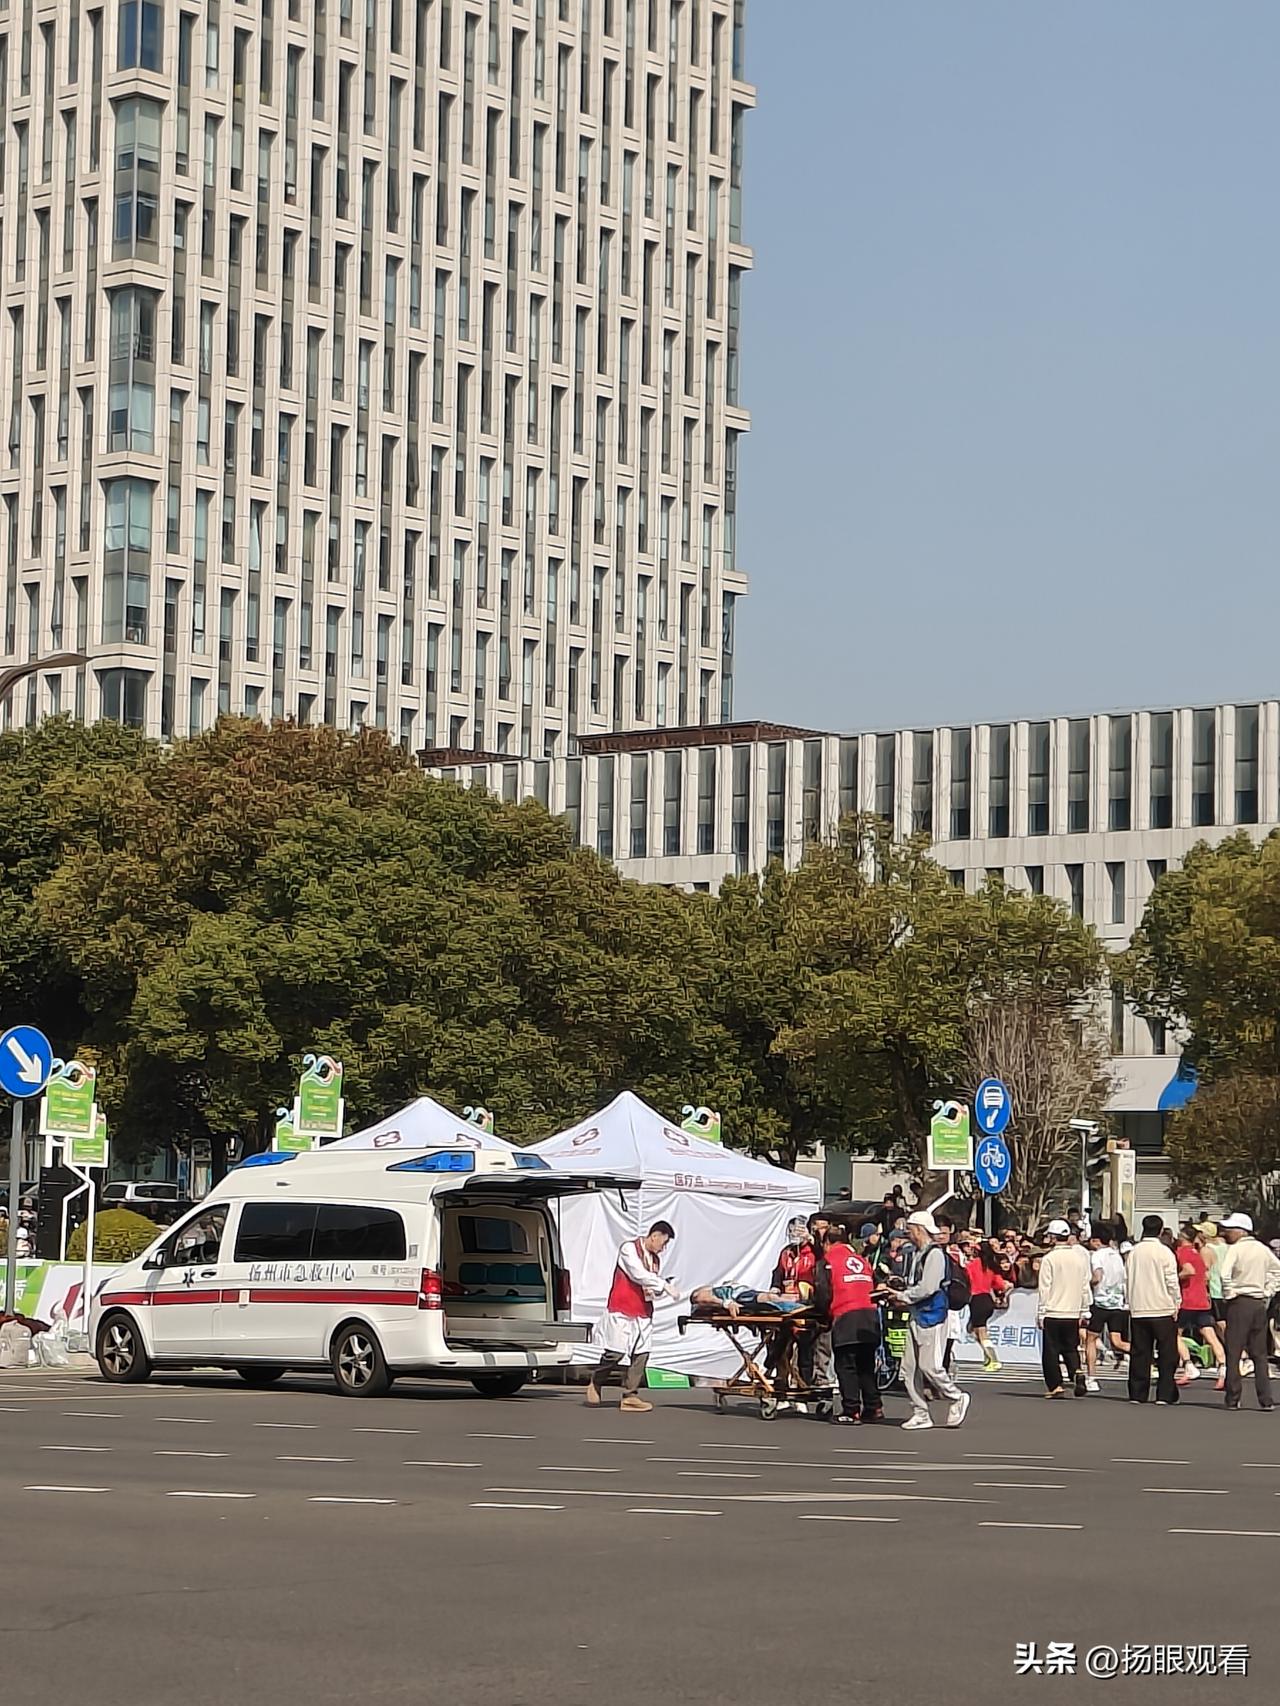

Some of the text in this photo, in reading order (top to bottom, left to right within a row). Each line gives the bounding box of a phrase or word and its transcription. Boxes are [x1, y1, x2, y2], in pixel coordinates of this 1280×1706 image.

[249, 1263, 355, 1282] 扬州市急救中心
